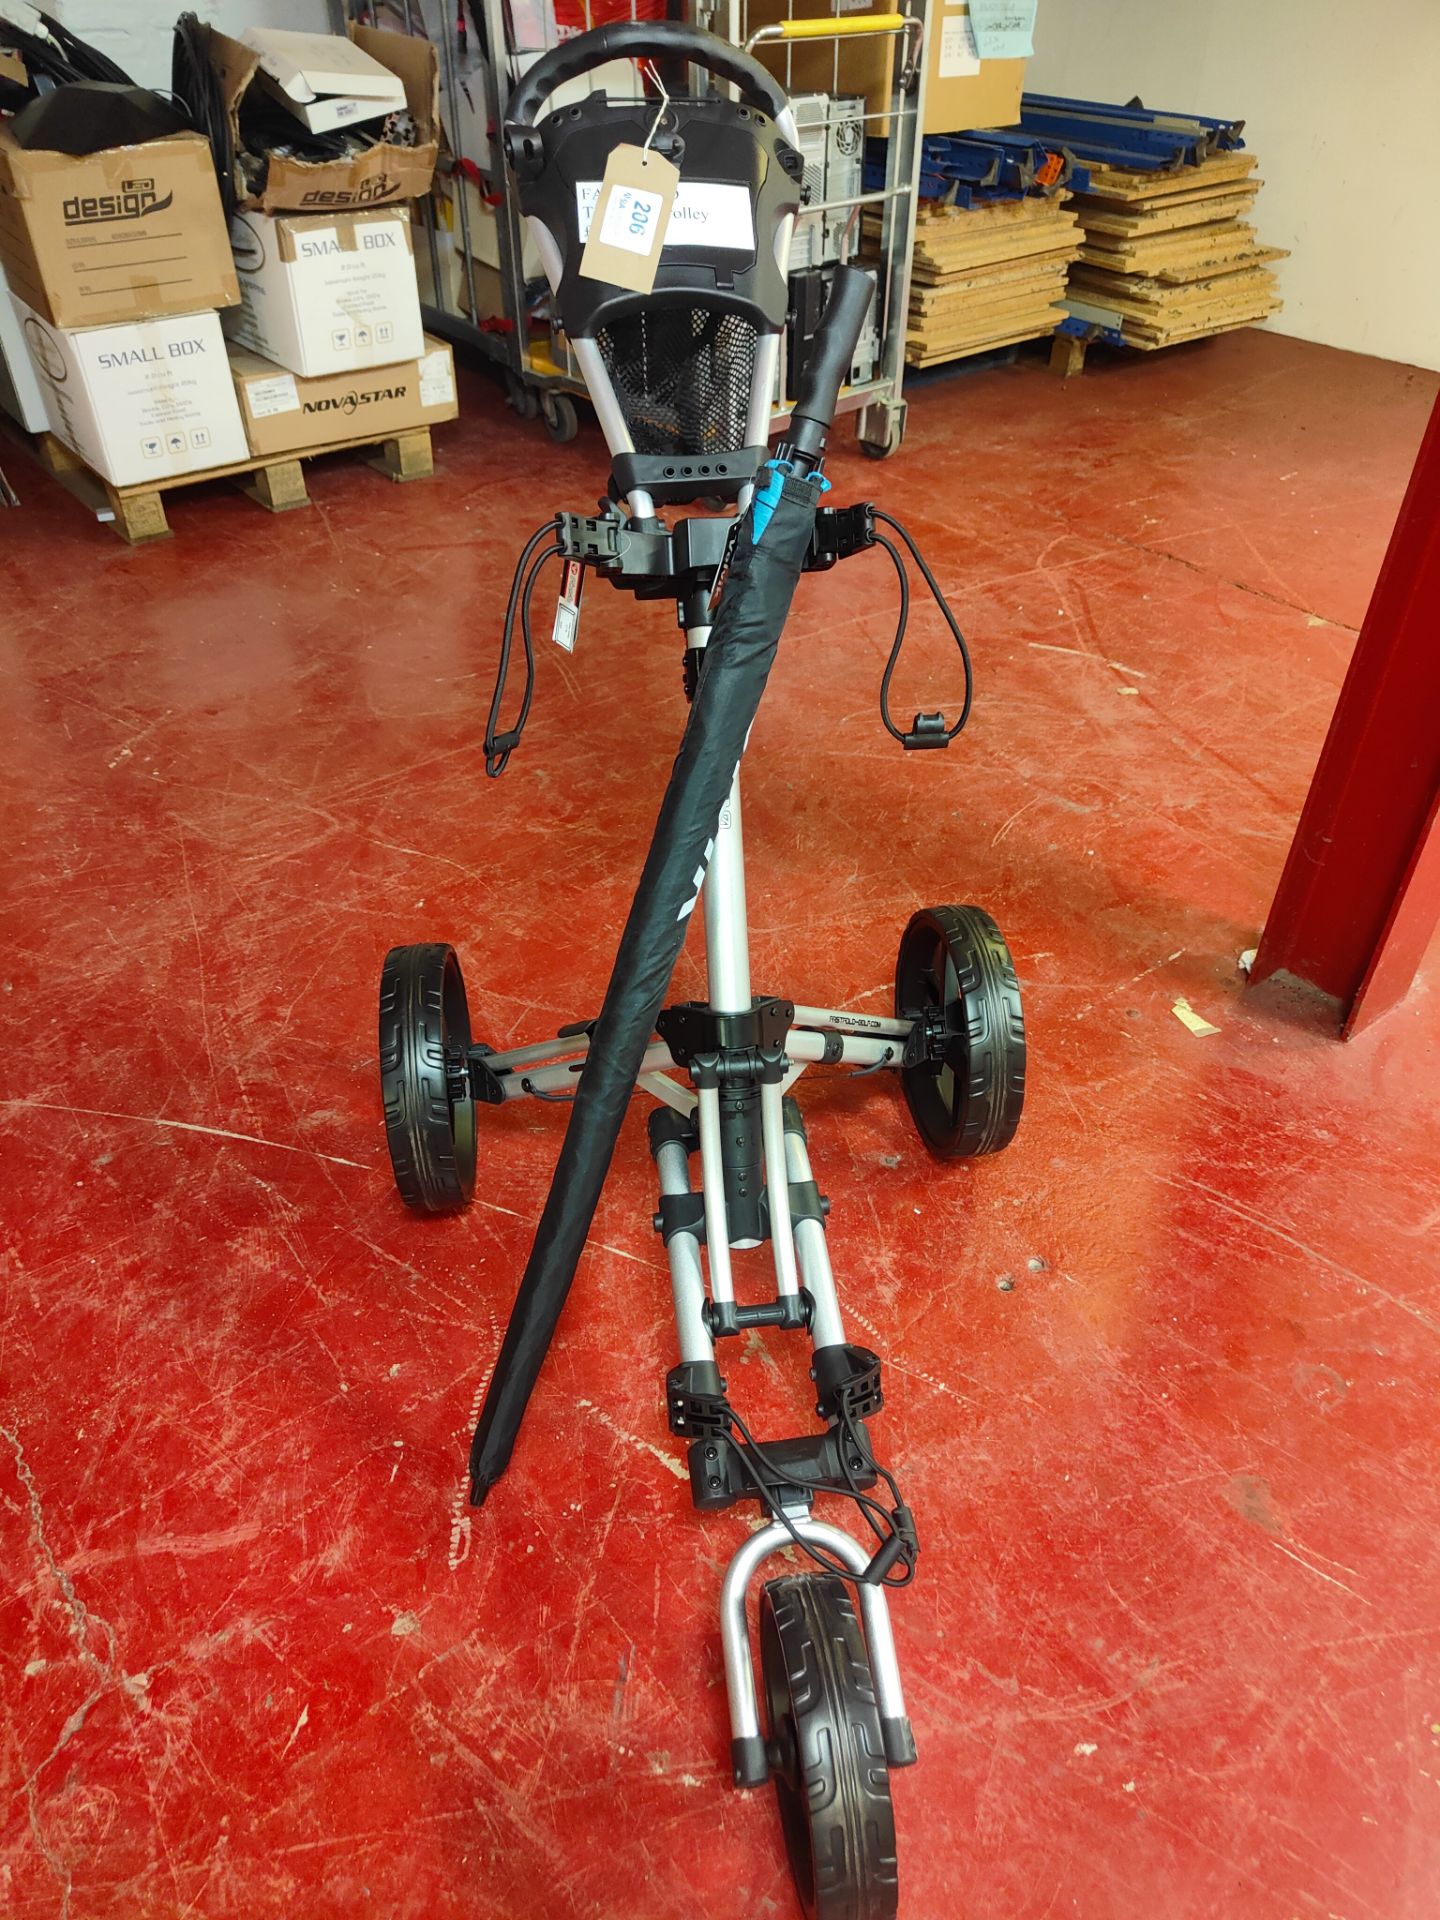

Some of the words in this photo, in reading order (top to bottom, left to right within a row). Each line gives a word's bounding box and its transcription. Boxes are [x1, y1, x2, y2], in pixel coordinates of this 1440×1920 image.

[63, 192, 157, 226] design
[628, 200, 652, 237] 206
[301, 239, 347, 258] SMA
[363, 232, 396, 250] BOX
[98, 347, 165, 369] SMALL
[168, 339, 206, 358] BOX
[303, 386, 407, 415] NOVASTAR
